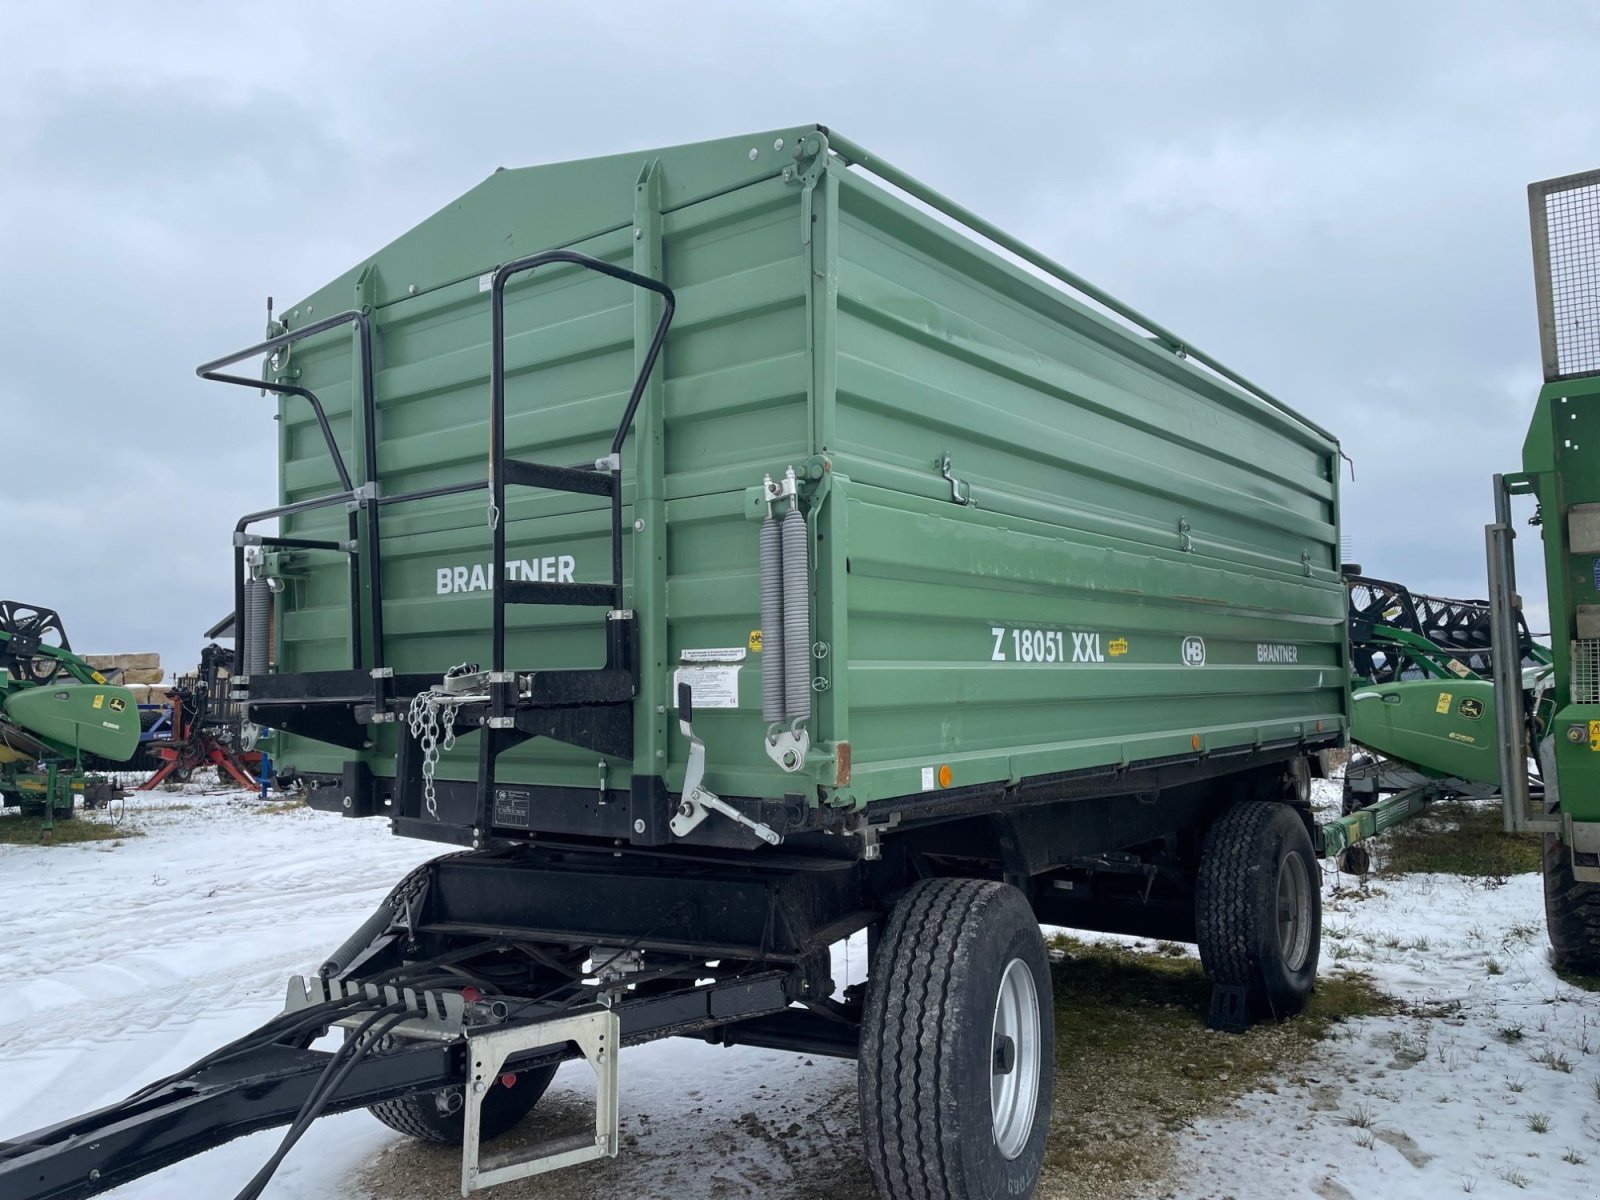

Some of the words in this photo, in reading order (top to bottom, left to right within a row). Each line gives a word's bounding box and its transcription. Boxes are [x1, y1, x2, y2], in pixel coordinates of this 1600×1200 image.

[992, 627, 1006, 661] Z
[1012, 629, 1064, 662] 18051
[1071, 632, 1104, 662] XXL
[1257, 644, 1298, 663] BRANTNER
